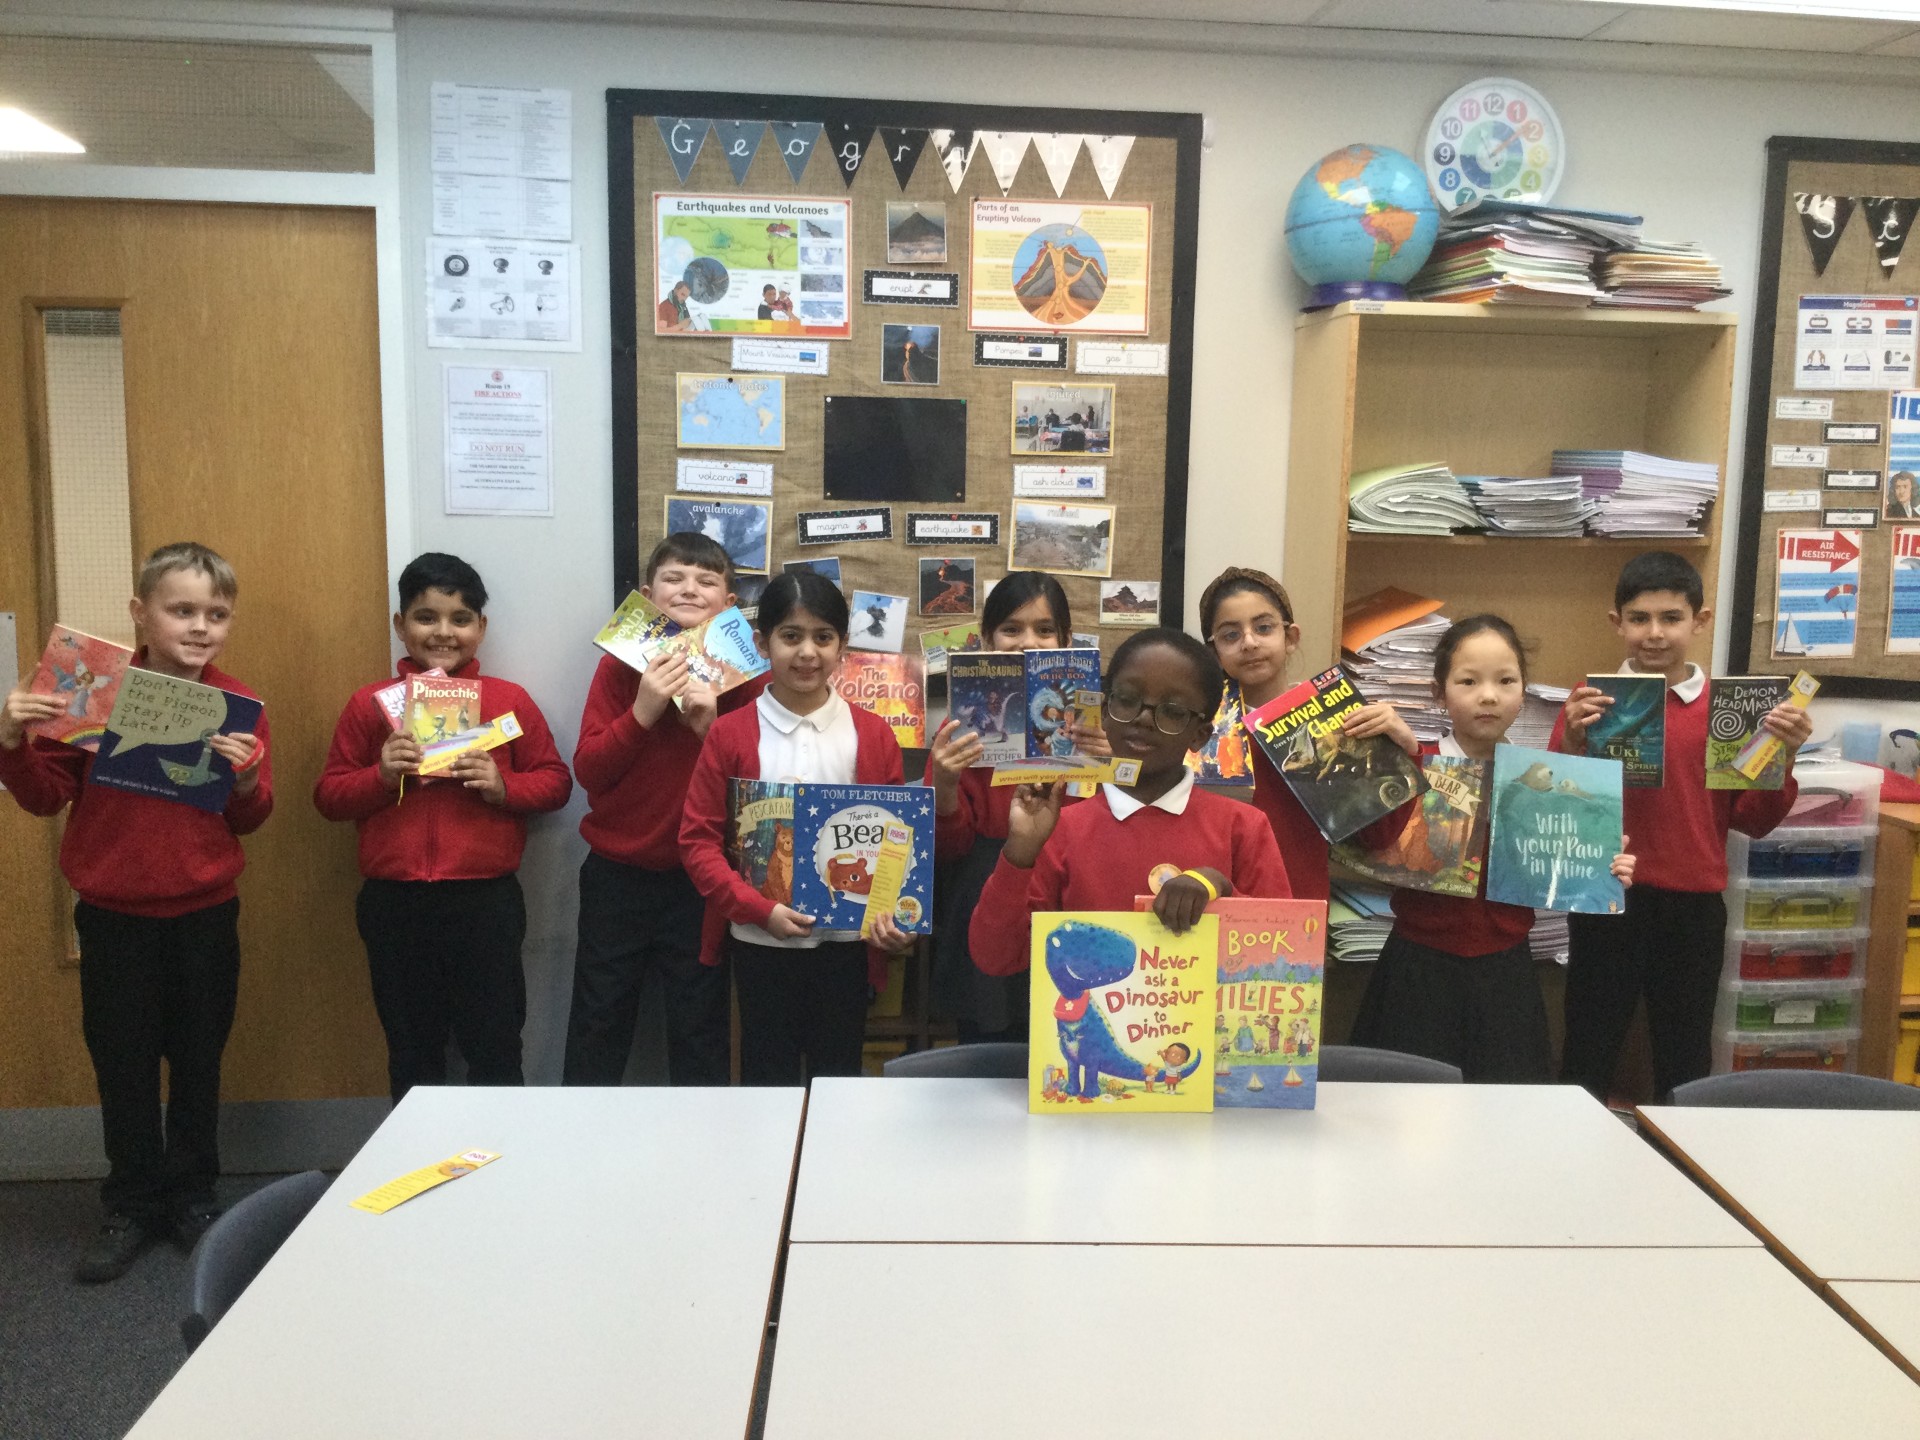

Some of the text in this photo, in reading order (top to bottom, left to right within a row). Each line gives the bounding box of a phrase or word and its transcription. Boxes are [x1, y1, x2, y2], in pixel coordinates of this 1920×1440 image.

[1463, 102, 1478, 114] 11
[1484, 95, 1501, 112] 12
[1513, 105, 1521, 119] 1
[1444, 121, 1461, 136] 10
[1529, 123, 1539, 139] 2
[1440, 147, 1450, 162] 9
[1534, 149, 1544, 164] 3
[1445, 172, 1456, 188] 8
[1525, 173, 1537, 188] 4
[677, 201, 829, 215] Earthquakes and Volcanoes
[977, 204, 998, 212] Parts
[1000, 204, 1008, 213] of
[976, 215, 1041, 224] Erupting Volcano
[889, 283, 915, 295] erupt
[1106, 356, 1121, 364] gas
[693, 380, 769, 392] tectonic plates
[471, 443, 524, 453] DO NOT RUN
[698, 471, 735, 482] volcano
[1033, 476, 1075, 486] ash cloud
[692, 505, 745, 516] avalanche
[816, 522, 849, 531] magma
[920, 524, 969, 536] earthquake
[1820, 542, 1834, 550] AIR
[1801, 550, 1851, 559] RESISTANCE
[612, 608, 645, 641] ROALD
[720, 618, 758, 666] Romans
[863, 667, 888, 681] The
[952, 665, 1023, 679] CHRISTMASAURUS
[1066, 672, 1086, 680] BOA
[132, 674, 178, 694] Don't
[412, 681, 479, 700] Pinocchio
[834, 676, 920, 699] Volcano
[128, 688, 155, 702] the
[1719, 686, 1778, 699] THE DEMON
[1254, 696, 1324, 744] Survival
[1322, 679, 1354, 708] and
[119, 716, 170, 735] Late!
[1273, 740, 1288, 750] Steve
[1607, 744, 1640, 757] UKI
[980, 753, 1022, 761] LETCHER
[1626, 762, 1657, 770] SPIRIT
[999, 775, 1022, 783] What
[1024, 774, 1039, 782] will
[1057, 773, 1099, 781] discover?
[1435, 776, 1461, 795] BEAR
[821, 789, 912, 802] TOM FLETCHER
[847, 811, 872, 822] There's
[1535, 812, 1577, 835] With
[830, 824, 885, 850] Bea
[865, 850, 880, 858] YOU
[1515, 837, 1603, 865] your Paw
[1530, 856, 1599, 880] in Mine
[1228, 930, 1295, 956] BOOK
[1140, 946, 1199, 970] Never
[1144, 973, 1179, 987] ask a
[1105, 988, 1203, 1013] Dinosaur
[1154, 1011, 1166, 1023] to
[1127, 1018, 1193, 1043] Dinner
